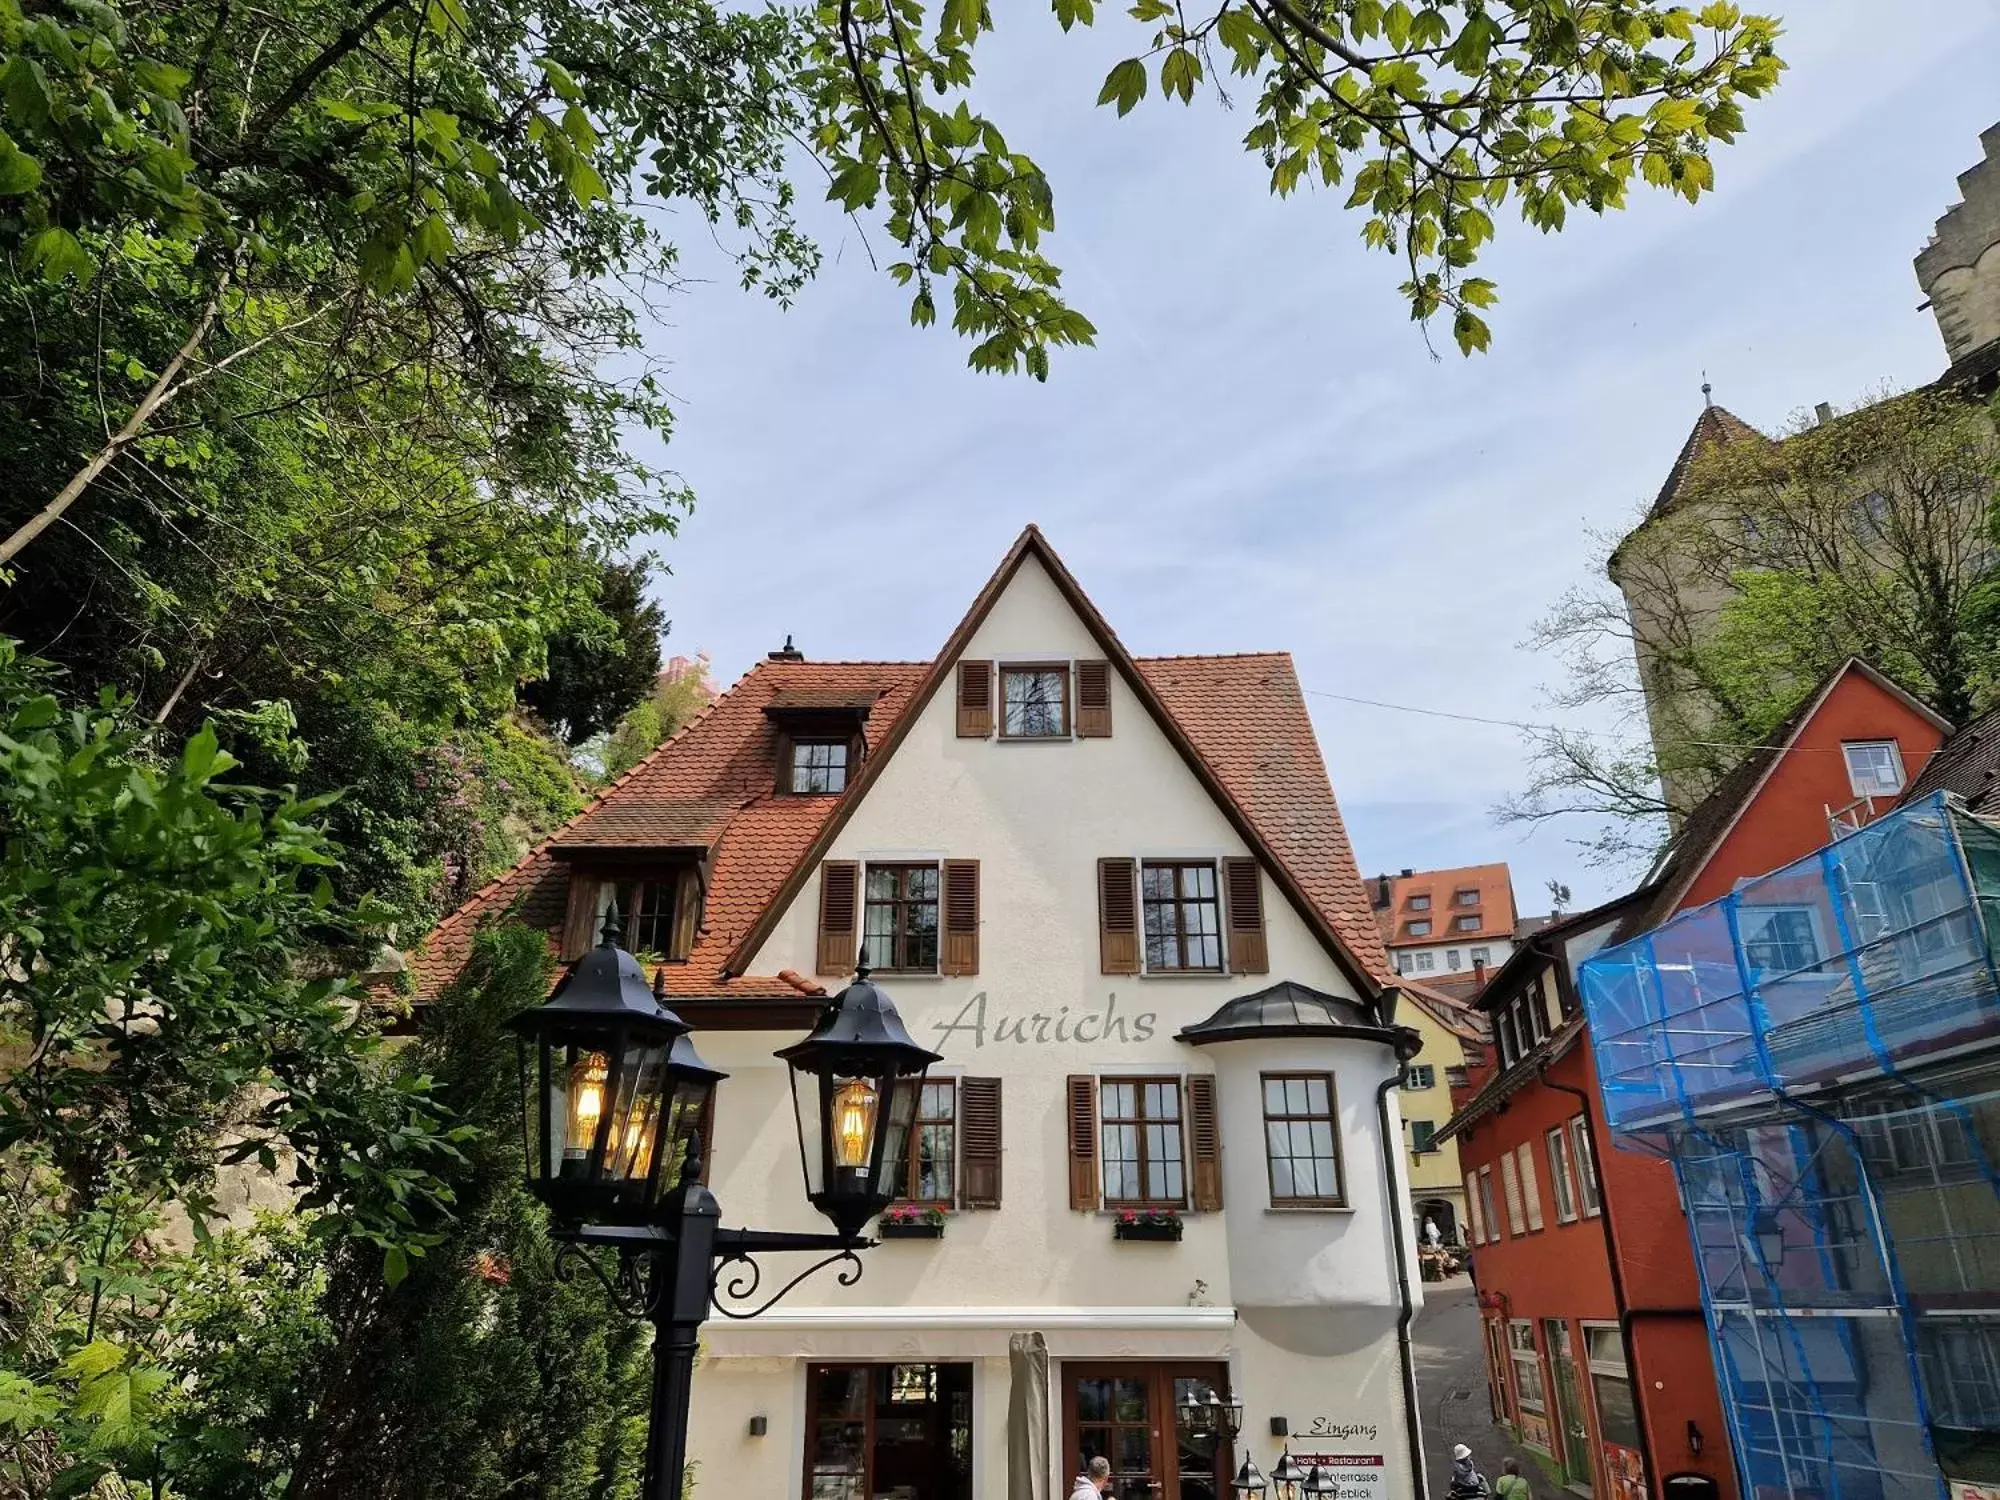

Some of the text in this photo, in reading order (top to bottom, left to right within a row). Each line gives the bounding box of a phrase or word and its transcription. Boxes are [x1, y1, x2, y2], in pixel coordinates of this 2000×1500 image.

[932, 991, 1156, 1053] Aurichs
[1310, 1416, 1377, 1440] Eingang
[1297, 1457, 1374, 1465] Hote Restaurant
